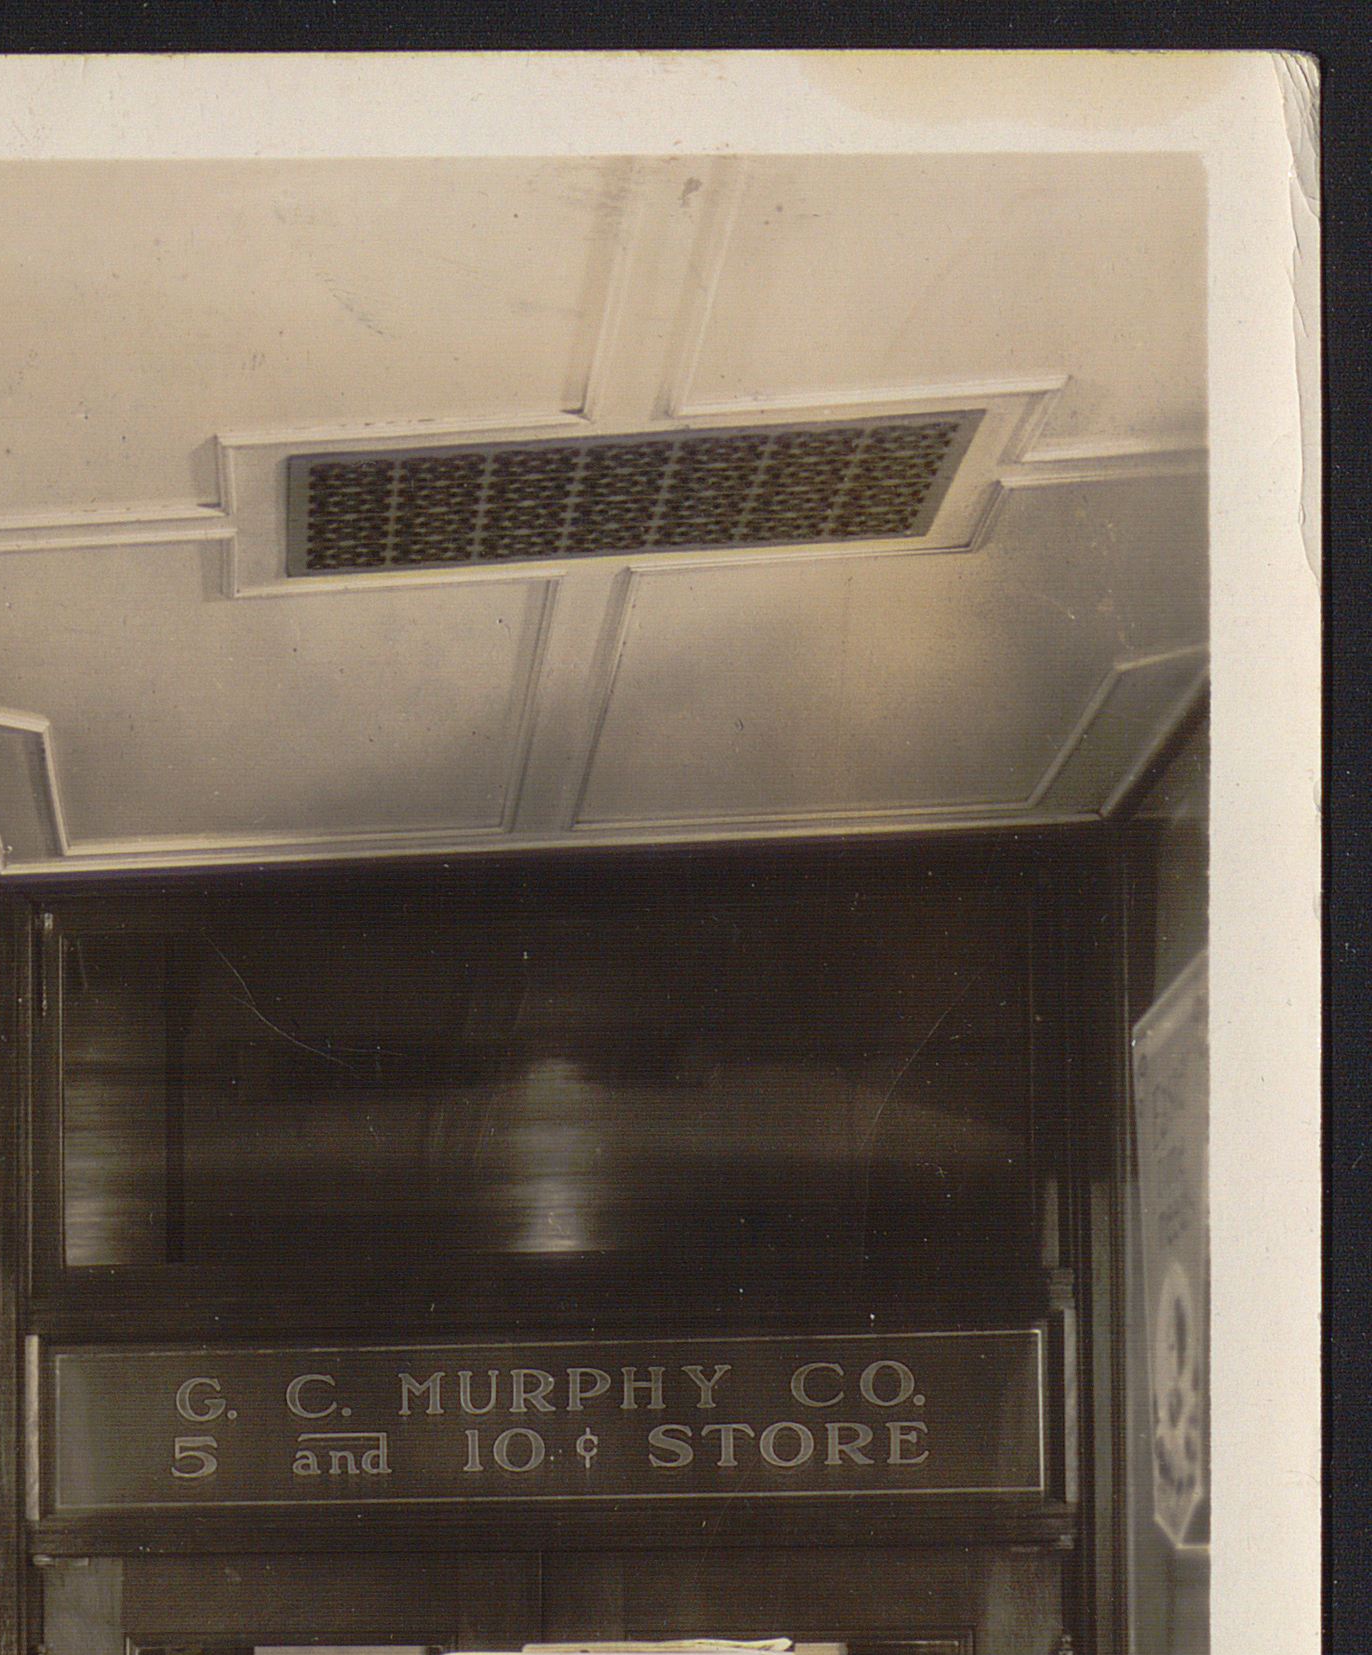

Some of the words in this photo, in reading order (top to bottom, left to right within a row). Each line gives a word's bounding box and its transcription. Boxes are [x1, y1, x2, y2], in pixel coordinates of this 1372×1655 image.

[175, 1376, 238, 1422] G.
[285, 1373, 352, 1419] C.
[397, 1365, 732, 1415] MURPHY
[790, 1360, 927, 1407] CO.
[170, 1436, 218, 1478] 5
[291, 1432, 392, 1475] and
[647, 1421, 930, 1468] STORE
